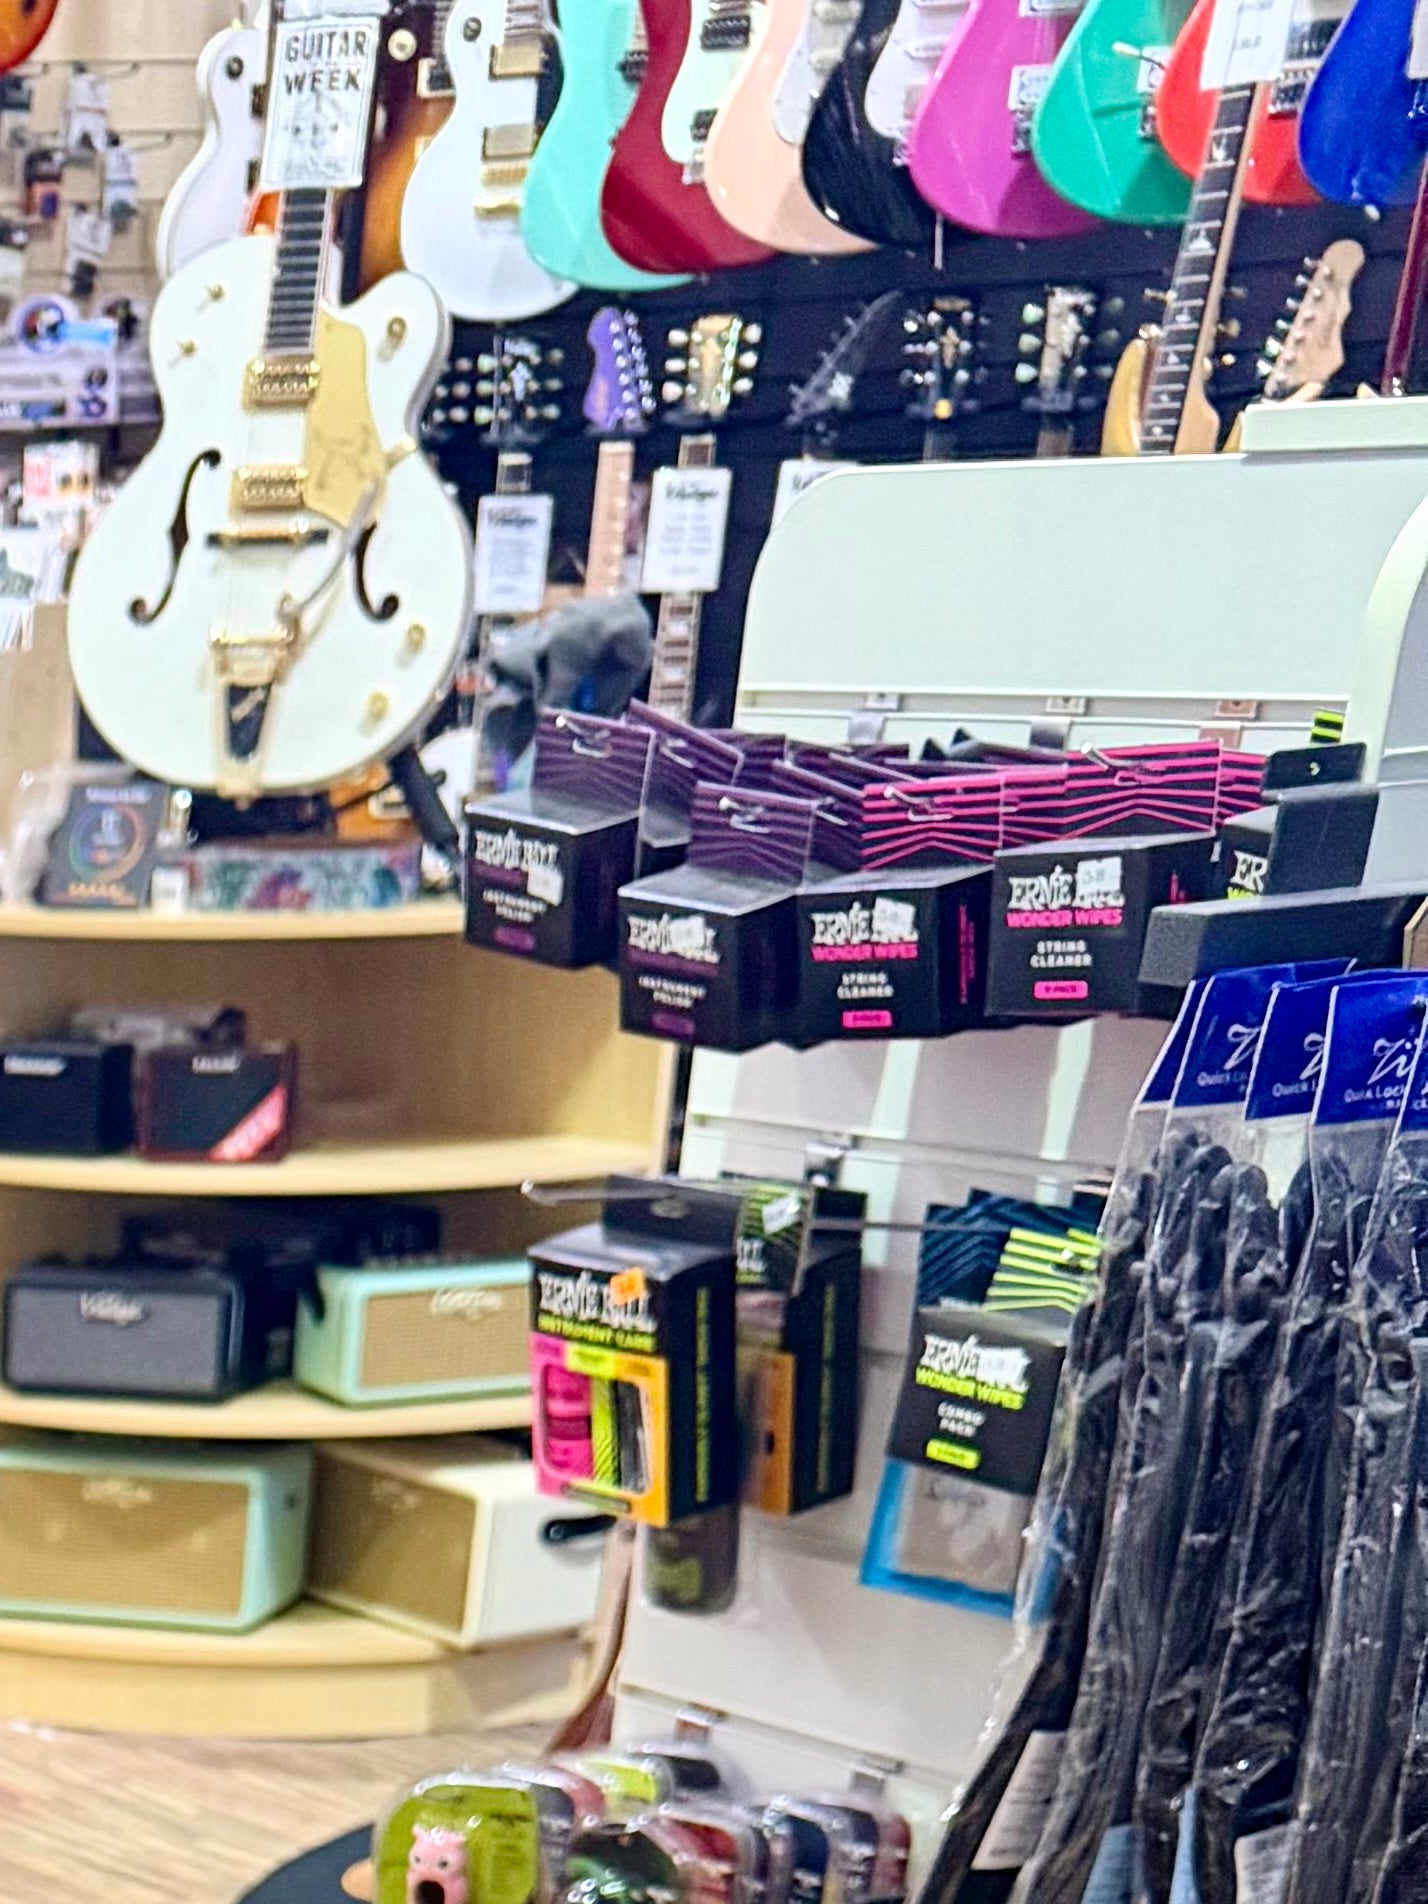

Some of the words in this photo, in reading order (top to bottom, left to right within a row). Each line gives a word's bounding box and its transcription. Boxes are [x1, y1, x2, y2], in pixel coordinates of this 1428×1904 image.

[286, 30, 368, 63] GUITAR
[284, 68, 362, 97] WEEK
[1008, 864, 1073, 911] ERNIE
[811, 901, 872, 946] ERNIE
[1006, 910, 1073, 929] WONDER
[1074, 908, 1123, 927] WIPES
